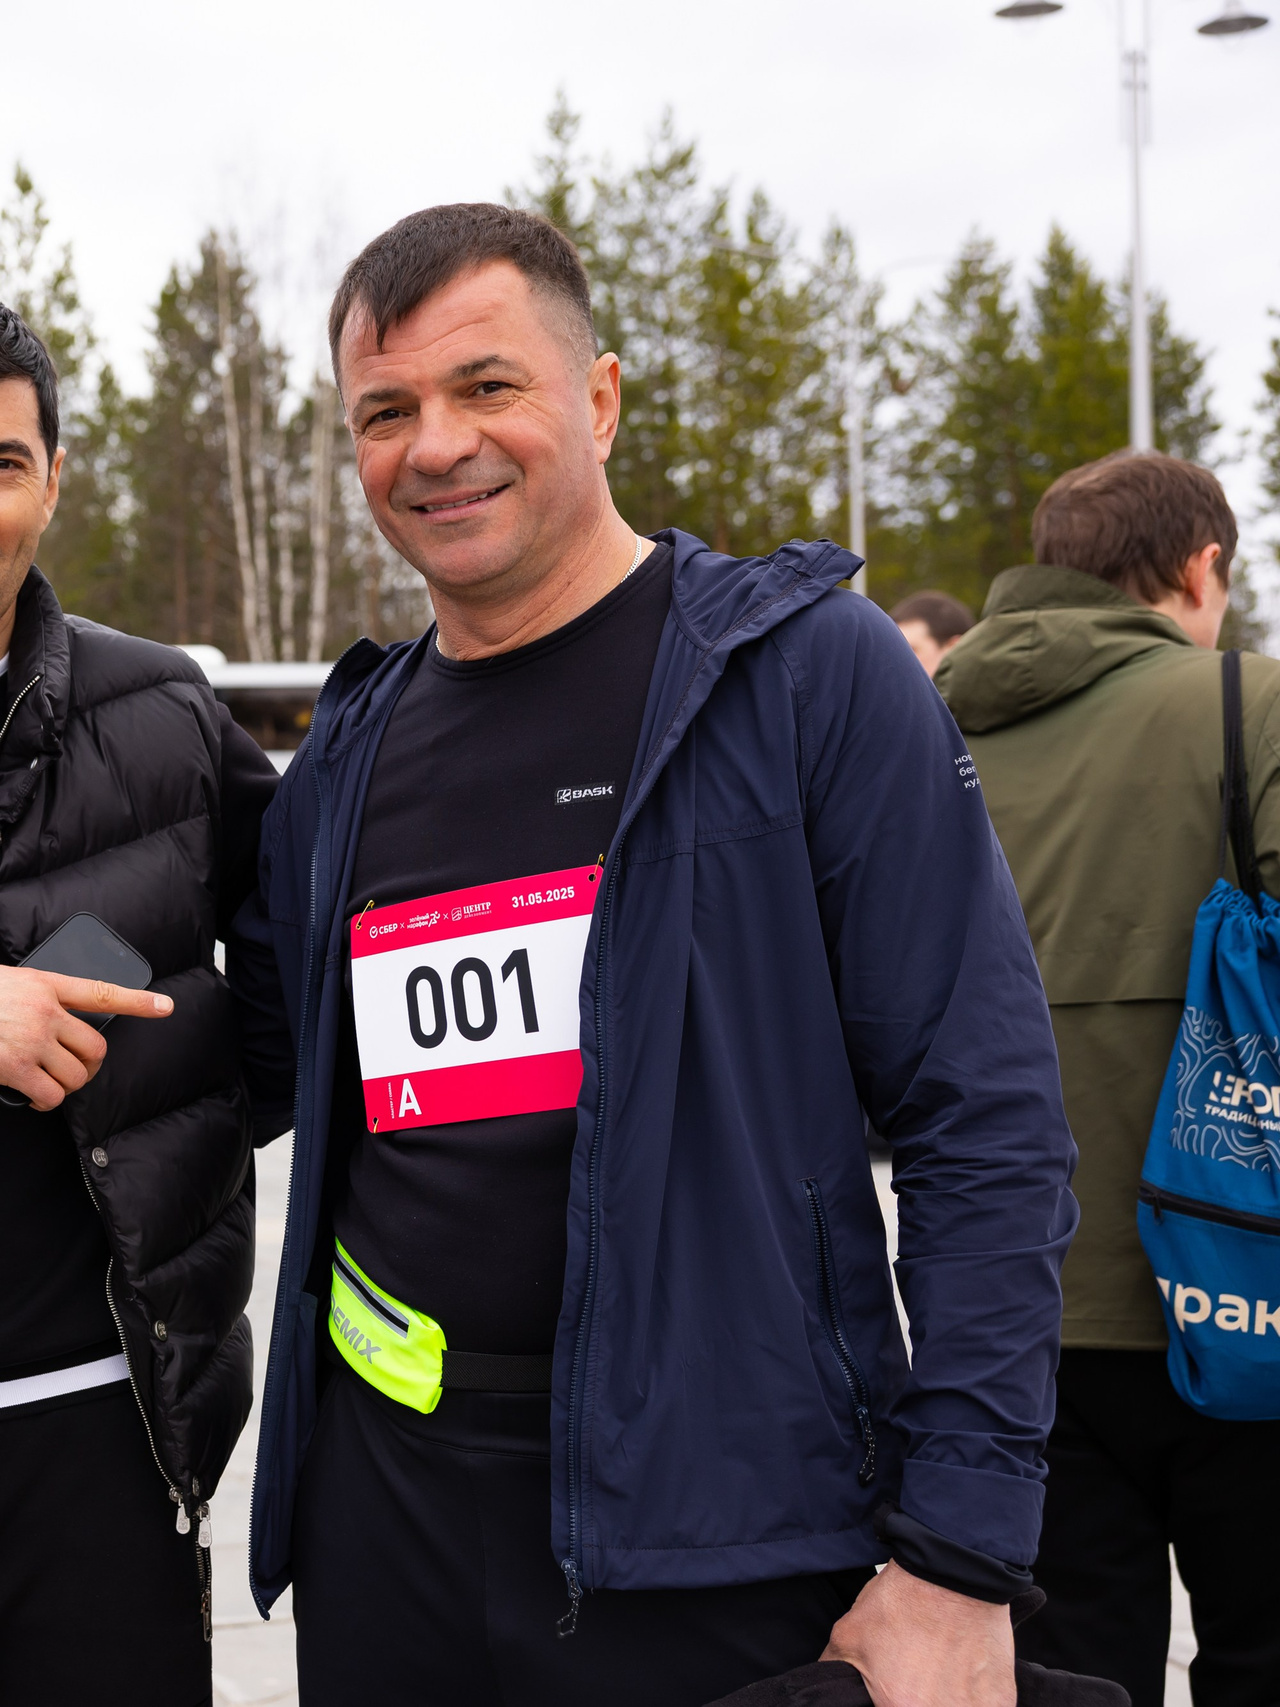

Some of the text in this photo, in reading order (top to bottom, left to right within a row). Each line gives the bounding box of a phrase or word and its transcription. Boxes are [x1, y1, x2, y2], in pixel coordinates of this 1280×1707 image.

[572, 785, 613, 799] BASK
[511, 886, 575, 908] 31.05.2025
[463, 901, 491, 915] ЦЕНТР
[378, 922, 398, 935] СБЕР
[405, 948, 539, 1049] 001
